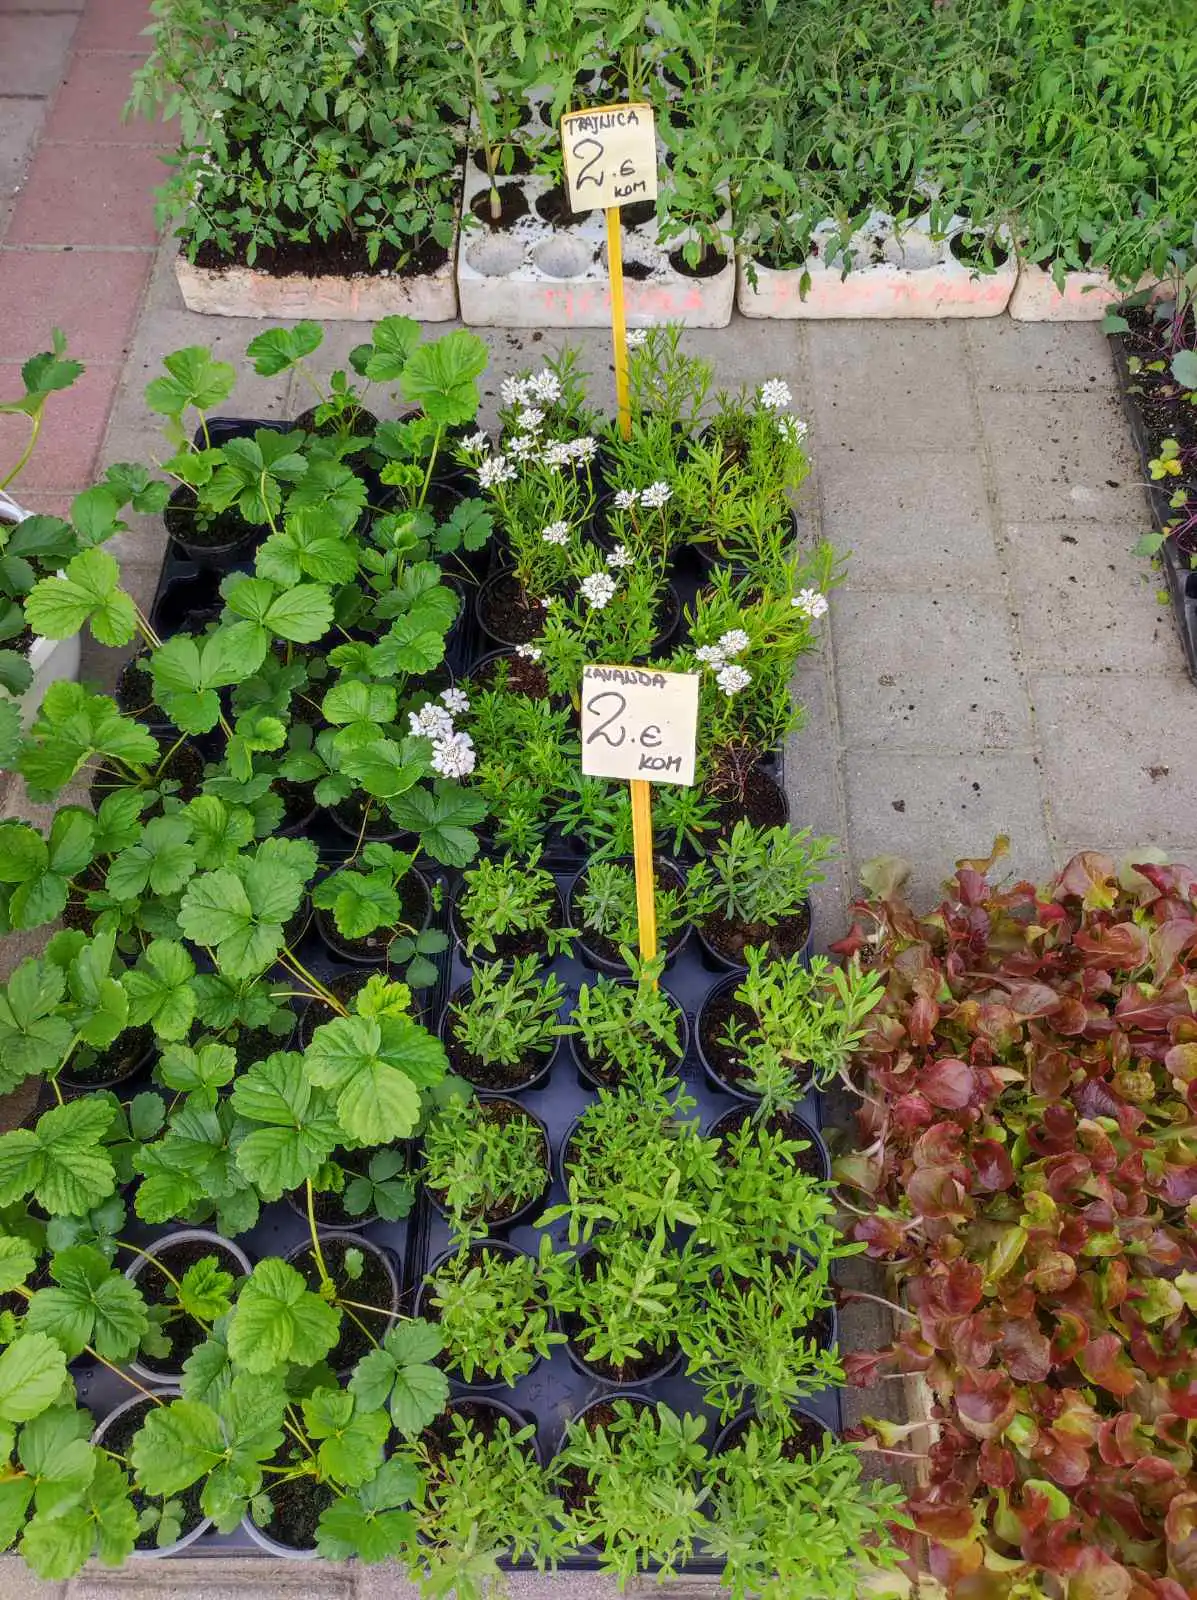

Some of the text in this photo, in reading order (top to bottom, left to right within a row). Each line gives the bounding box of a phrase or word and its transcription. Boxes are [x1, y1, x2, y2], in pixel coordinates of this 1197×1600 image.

[564, 110, 640, 136] TRAJNICA
[614, 180, 646, 198] KOM
[584, 668, 668, 688] LAVANDA
[638, 753, 682, 773] KOM
